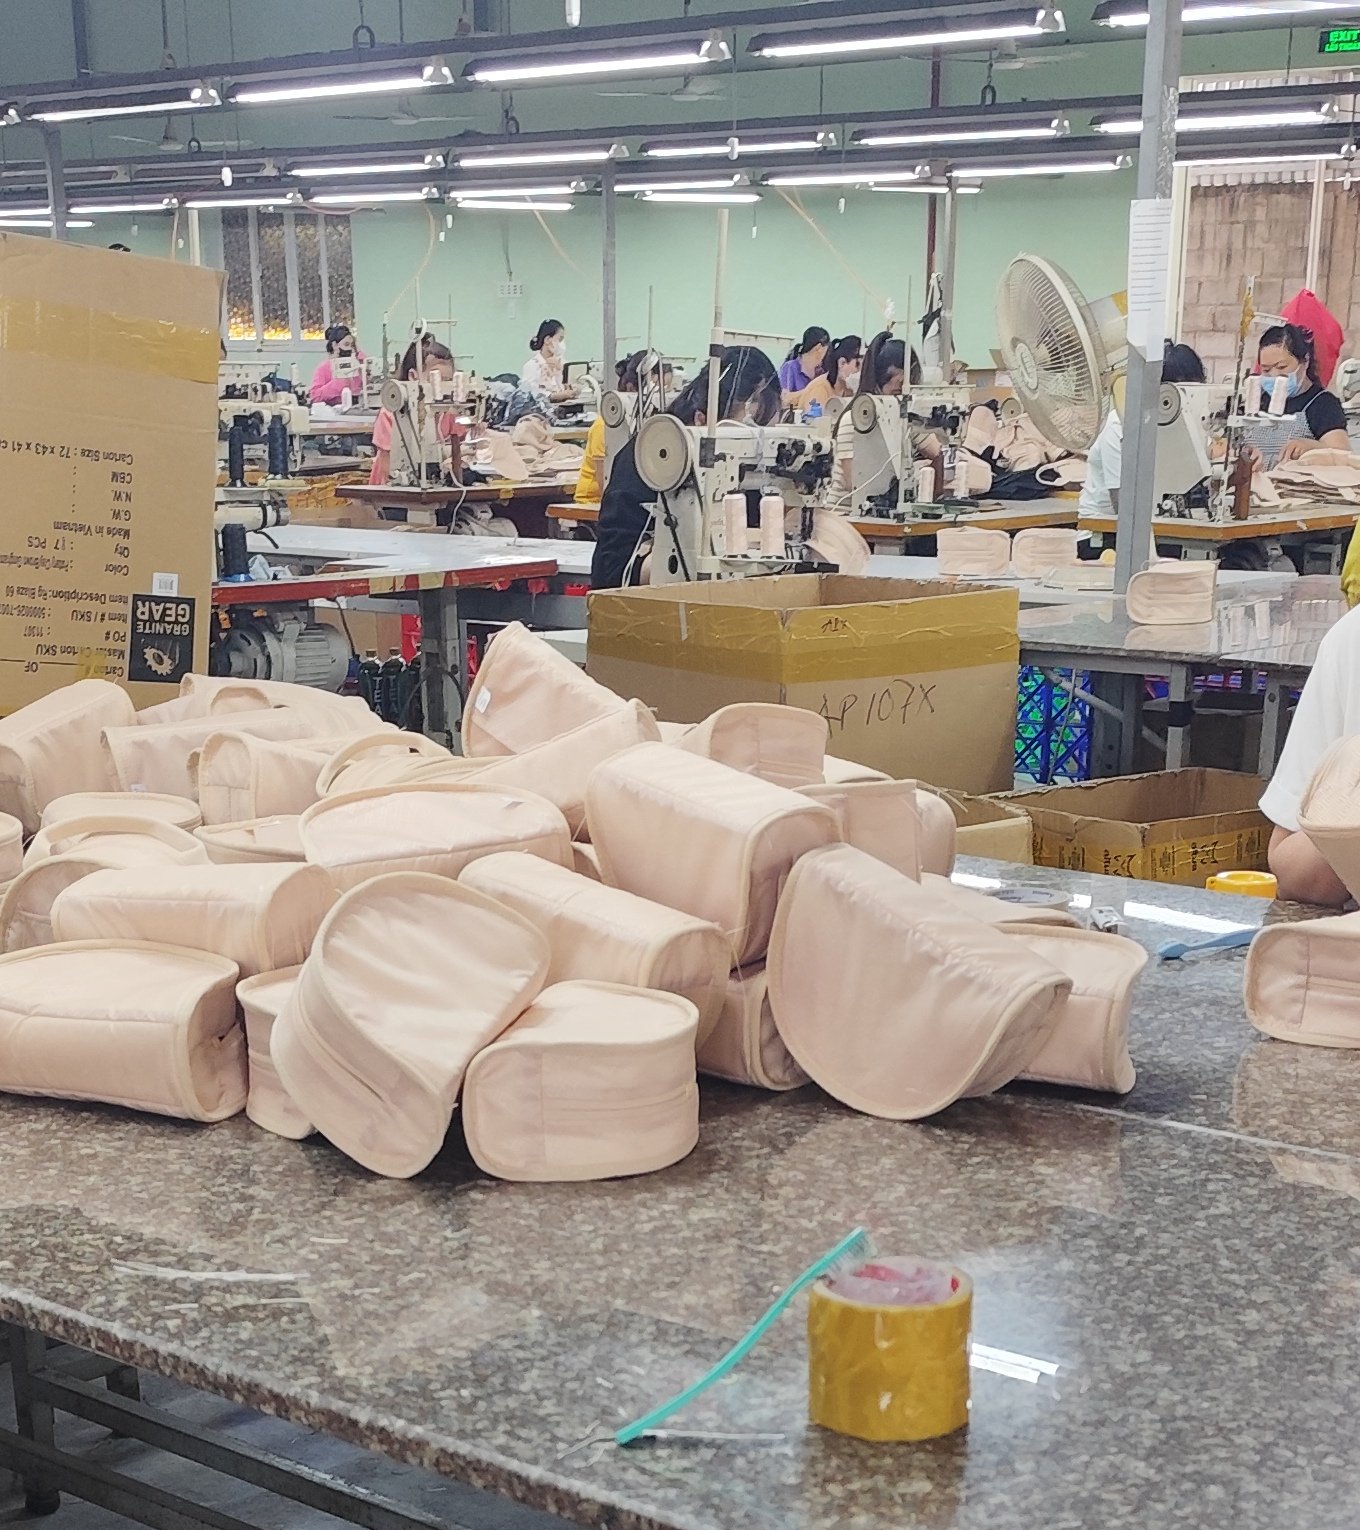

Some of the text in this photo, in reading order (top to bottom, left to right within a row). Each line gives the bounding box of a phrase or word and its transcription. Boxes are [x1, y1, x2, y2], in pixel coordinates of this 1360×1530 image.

[11, 440, 23, 454] 41
[59, 445, 71, 458] 72
[103, 451, 133, 465] Carton
[53, 521, 130, 540] Made in Vietnam
[27, 536, 47, 549] PCS
[115, 543, 130, 558] Qty
[105, 563, 129, 576] Color
[71, 609, 92, 622] SKU
[109, 612, 127, 624] Item
[136, 601, 190, 622] GEAR
[136, 622, 189, 636] GRANITE
[113, 631, 127, 642] PO
[36, 644, 57, 655] SKU
